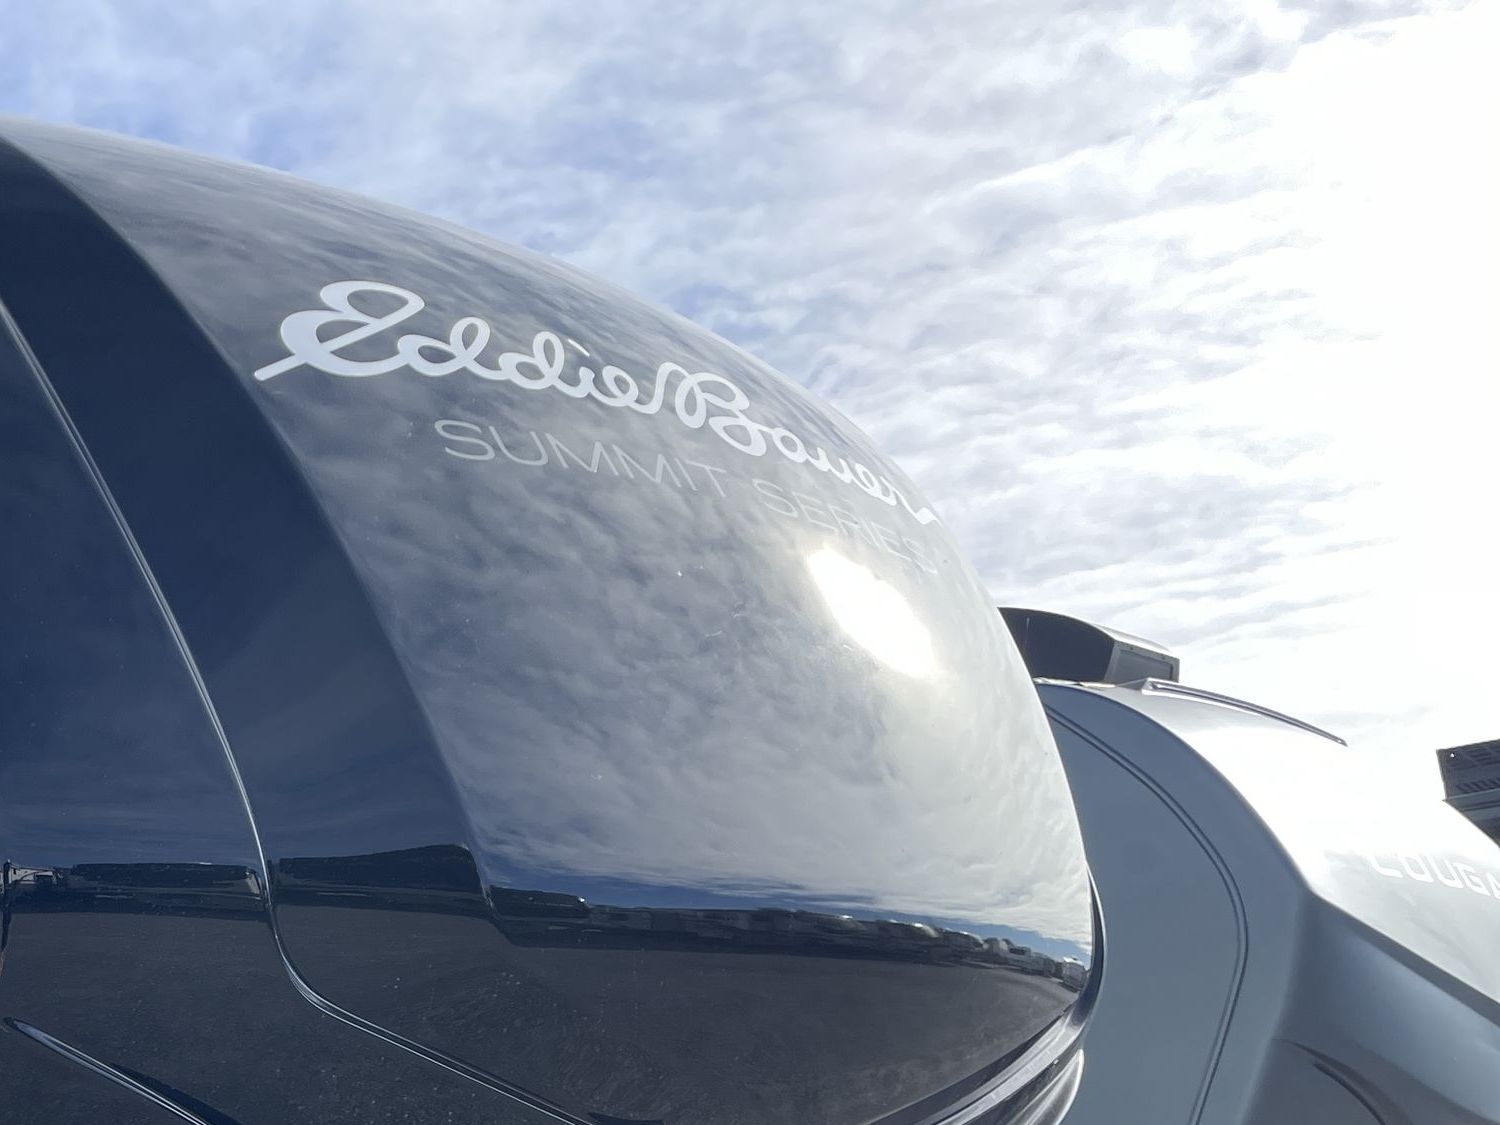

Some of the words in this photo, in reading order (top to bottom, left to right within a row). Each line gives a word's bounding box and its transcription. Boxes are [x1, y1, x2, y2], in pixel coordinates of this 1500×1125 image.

[254, 280, 642, 414] Eddie
[640, 361, 943, 528] Bauer
[434, 418, 727, 498] SUMMIT
[752, 477, 938, 575] SERIES
